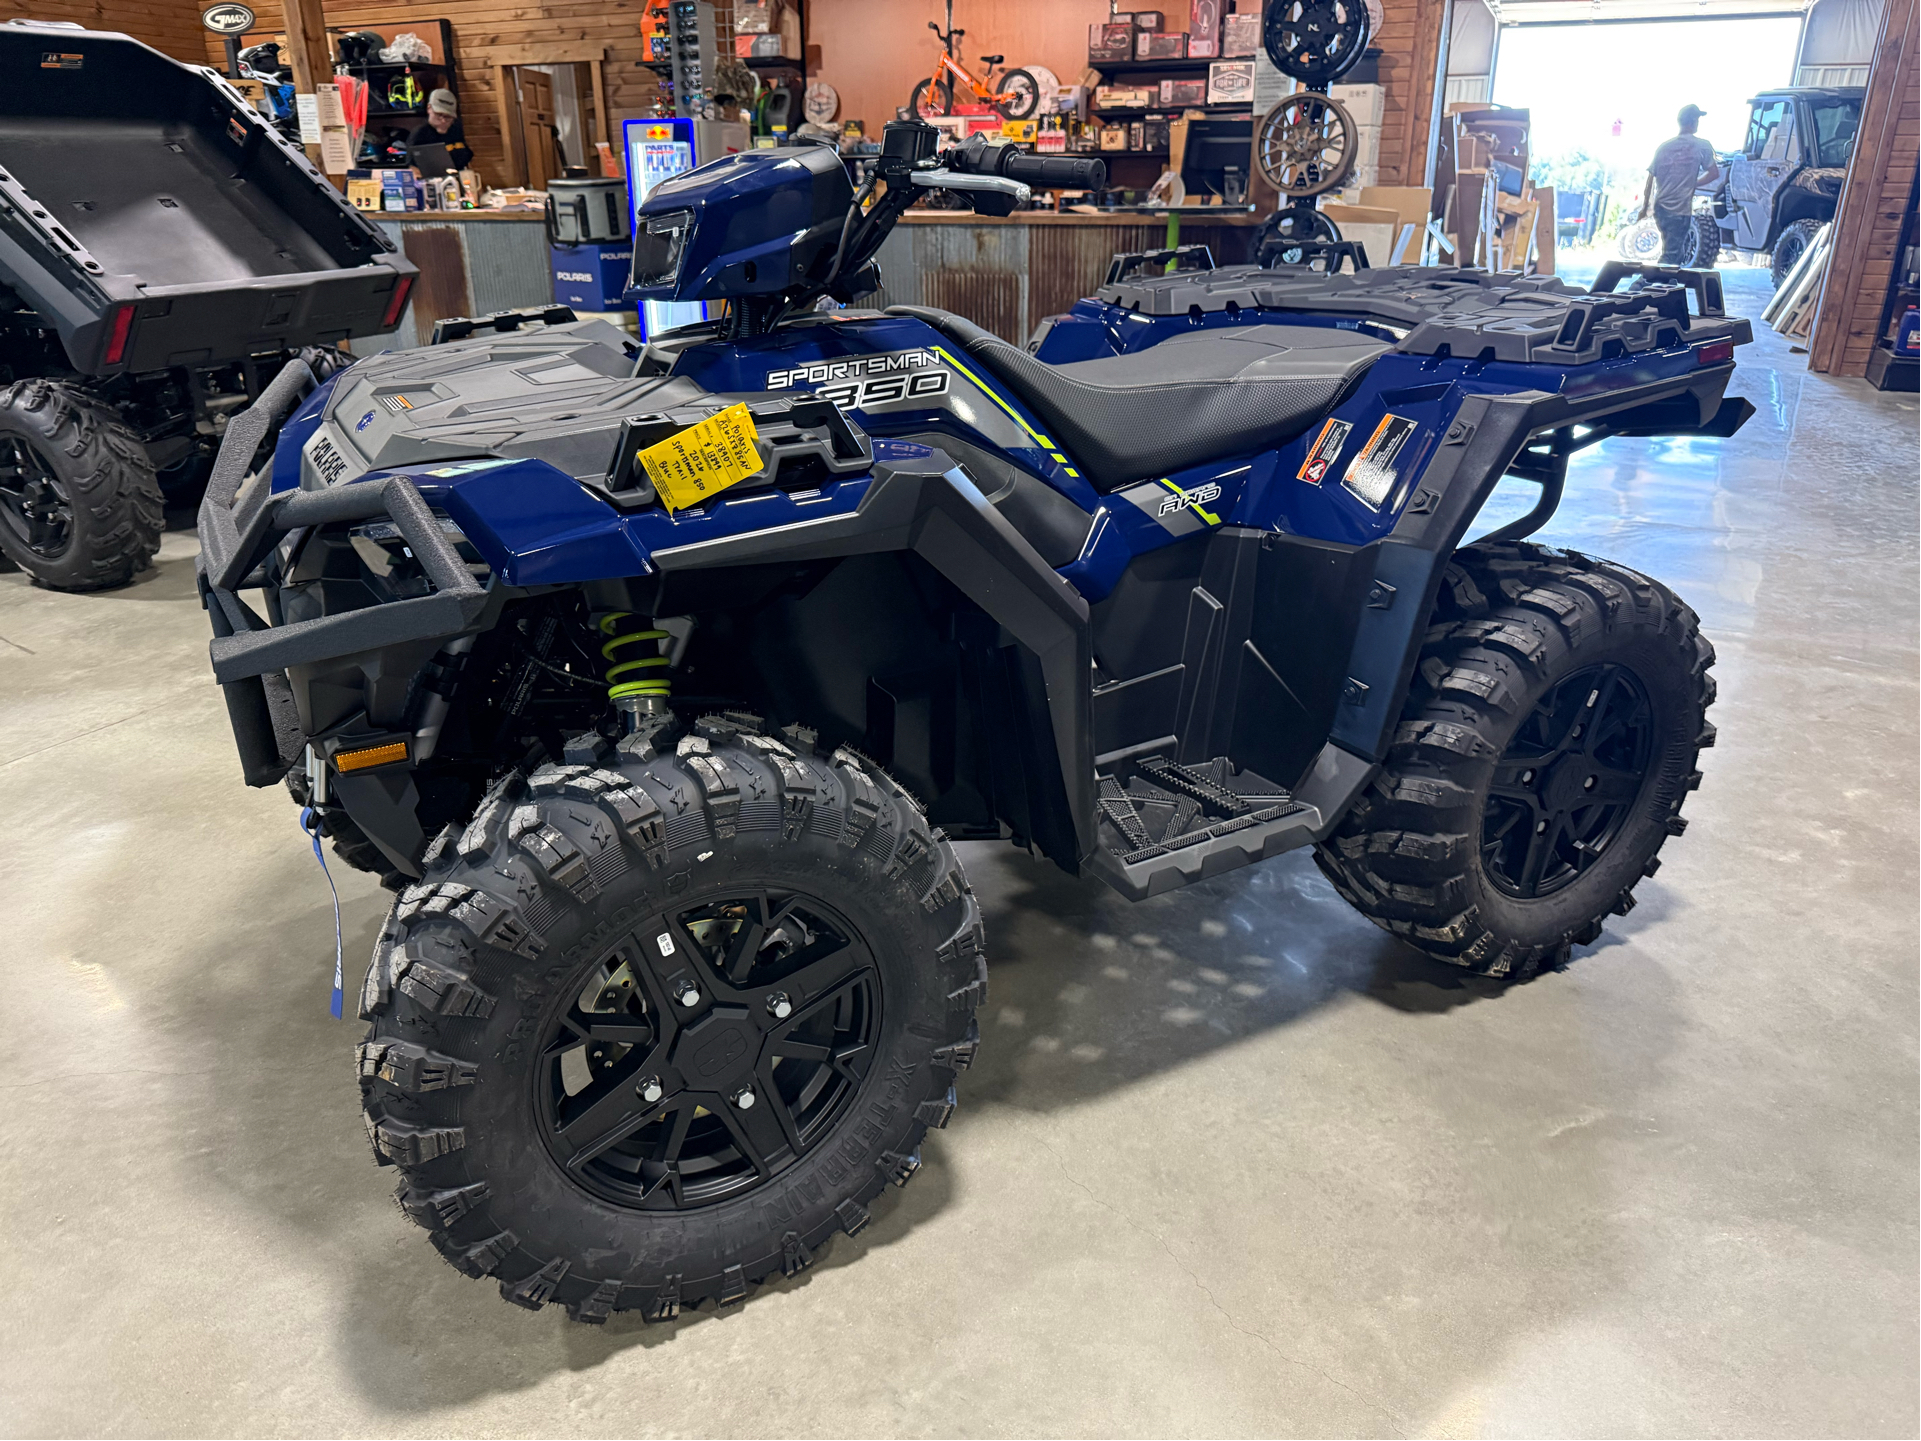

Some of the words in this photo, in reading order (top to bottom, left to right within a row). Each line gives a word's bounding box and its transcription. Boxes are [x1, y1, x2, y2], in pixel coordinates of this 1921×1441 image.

[600, 252, 633, 260] POLARI
[556, 271, 593, 283] POLARIS
[766, 350, 940, 390] SPORTSMAN
[815, 369, 951, 412] 850
[731, 424, 751, 455] Polaris
[309, 436, 349, 487] POLARIS
[693, 477, 706, 491] 850
[1158, 486, 1222, 517] AWD
[510, 683, 530, 716] POLARIS
[761, 1055, 918, 1232] X-TERRAIN
